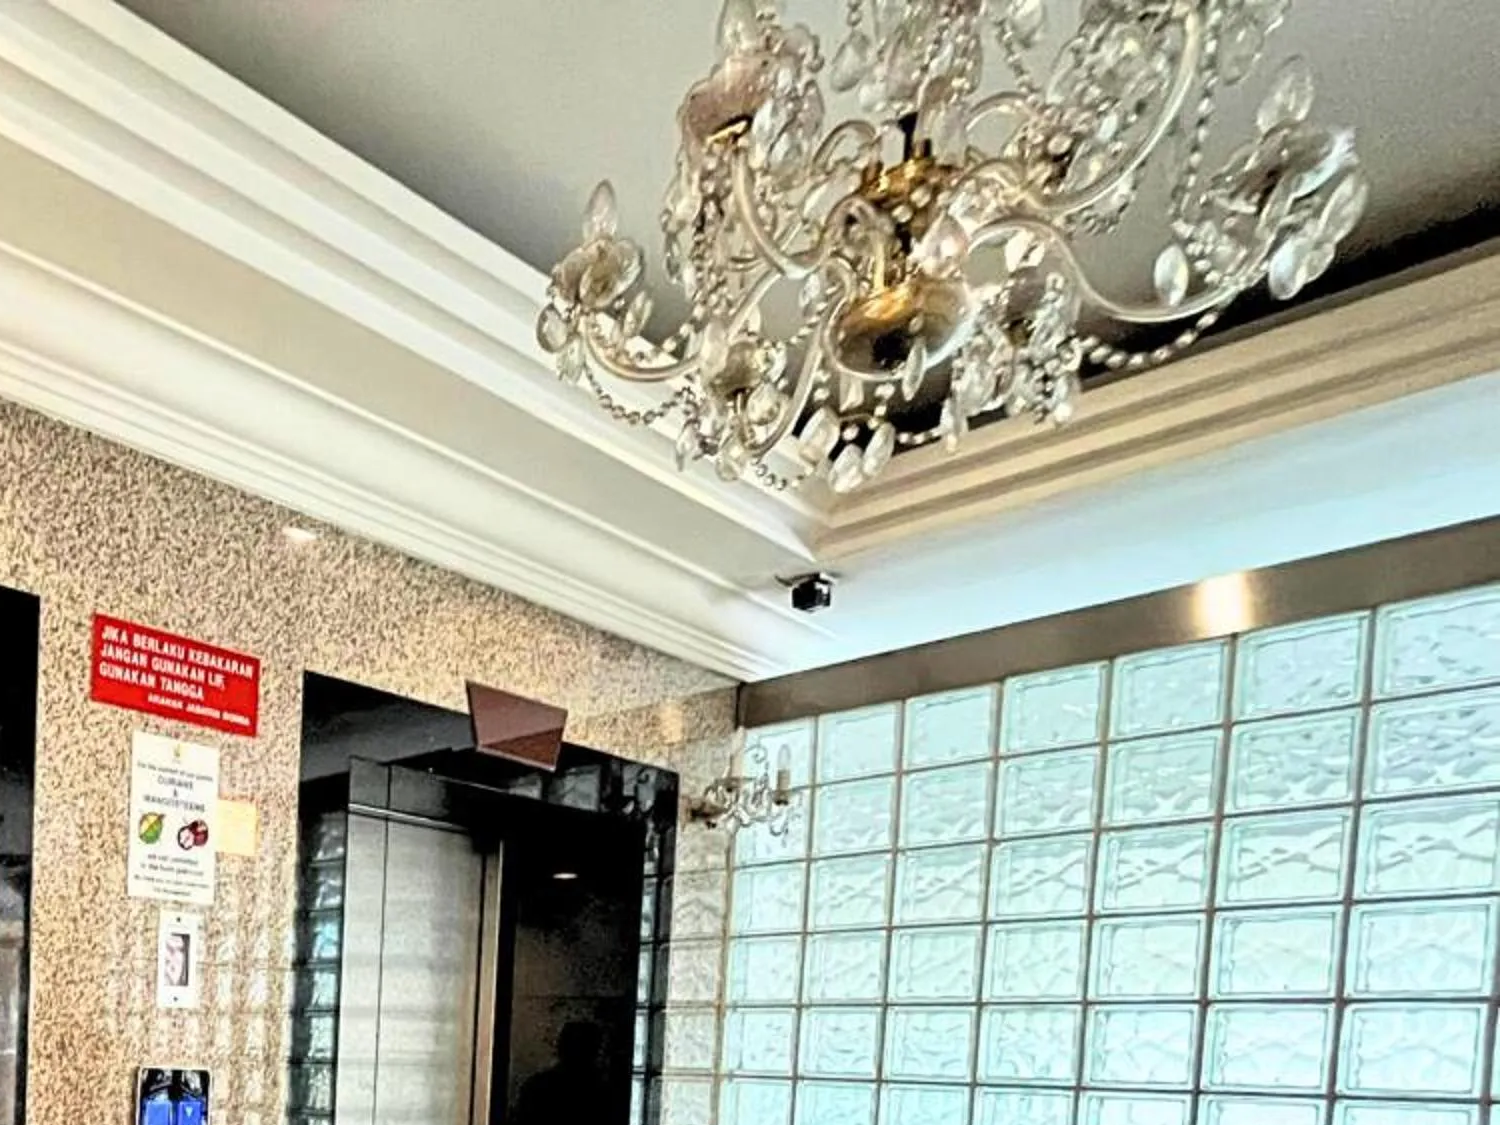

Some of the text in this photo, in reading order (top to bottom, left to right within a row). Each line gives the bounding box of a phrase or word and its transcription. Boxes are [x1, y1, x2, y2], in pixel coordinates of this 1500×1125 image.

[101, 642, 148, 668] JANGAN
[151, 656, 205, 683] GUNAKAN
[102, 625, 254, 678] JIKA BERLAKU KEBAKARAN
[99, 661, 204, 702] GUNAKAN TANGGA
